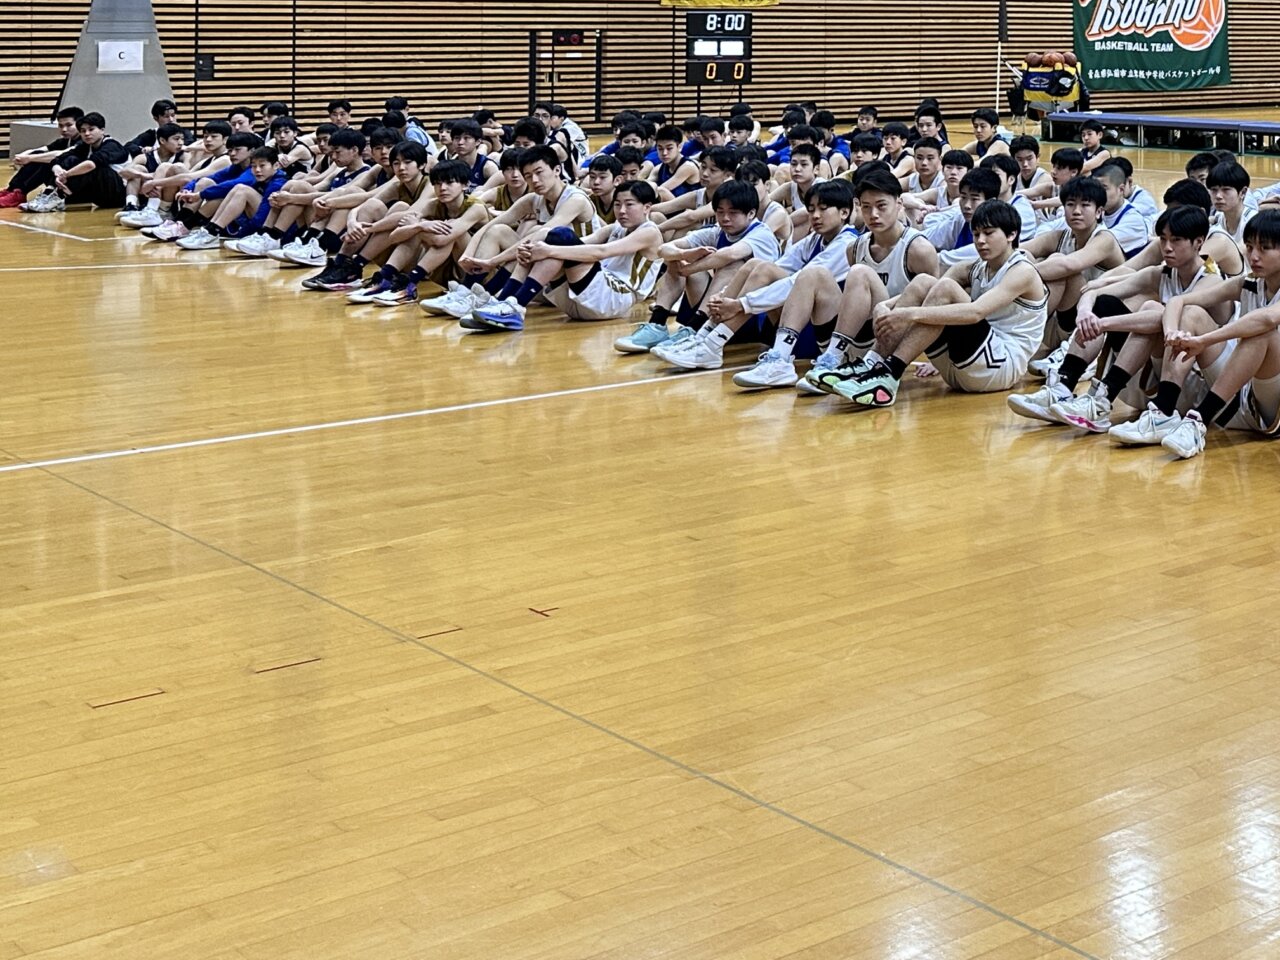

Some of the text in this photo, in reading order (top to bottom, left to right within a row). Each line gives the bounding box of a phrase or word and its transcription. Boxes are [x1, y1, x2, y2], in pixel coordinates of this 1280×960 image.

[706, 14, 745, 31] 8:00
[1094, 41, 1174, 52] BASKETBALL TEAM
[118, 51, 126, 60] C
[706, 63, 744, 79] 0 0
